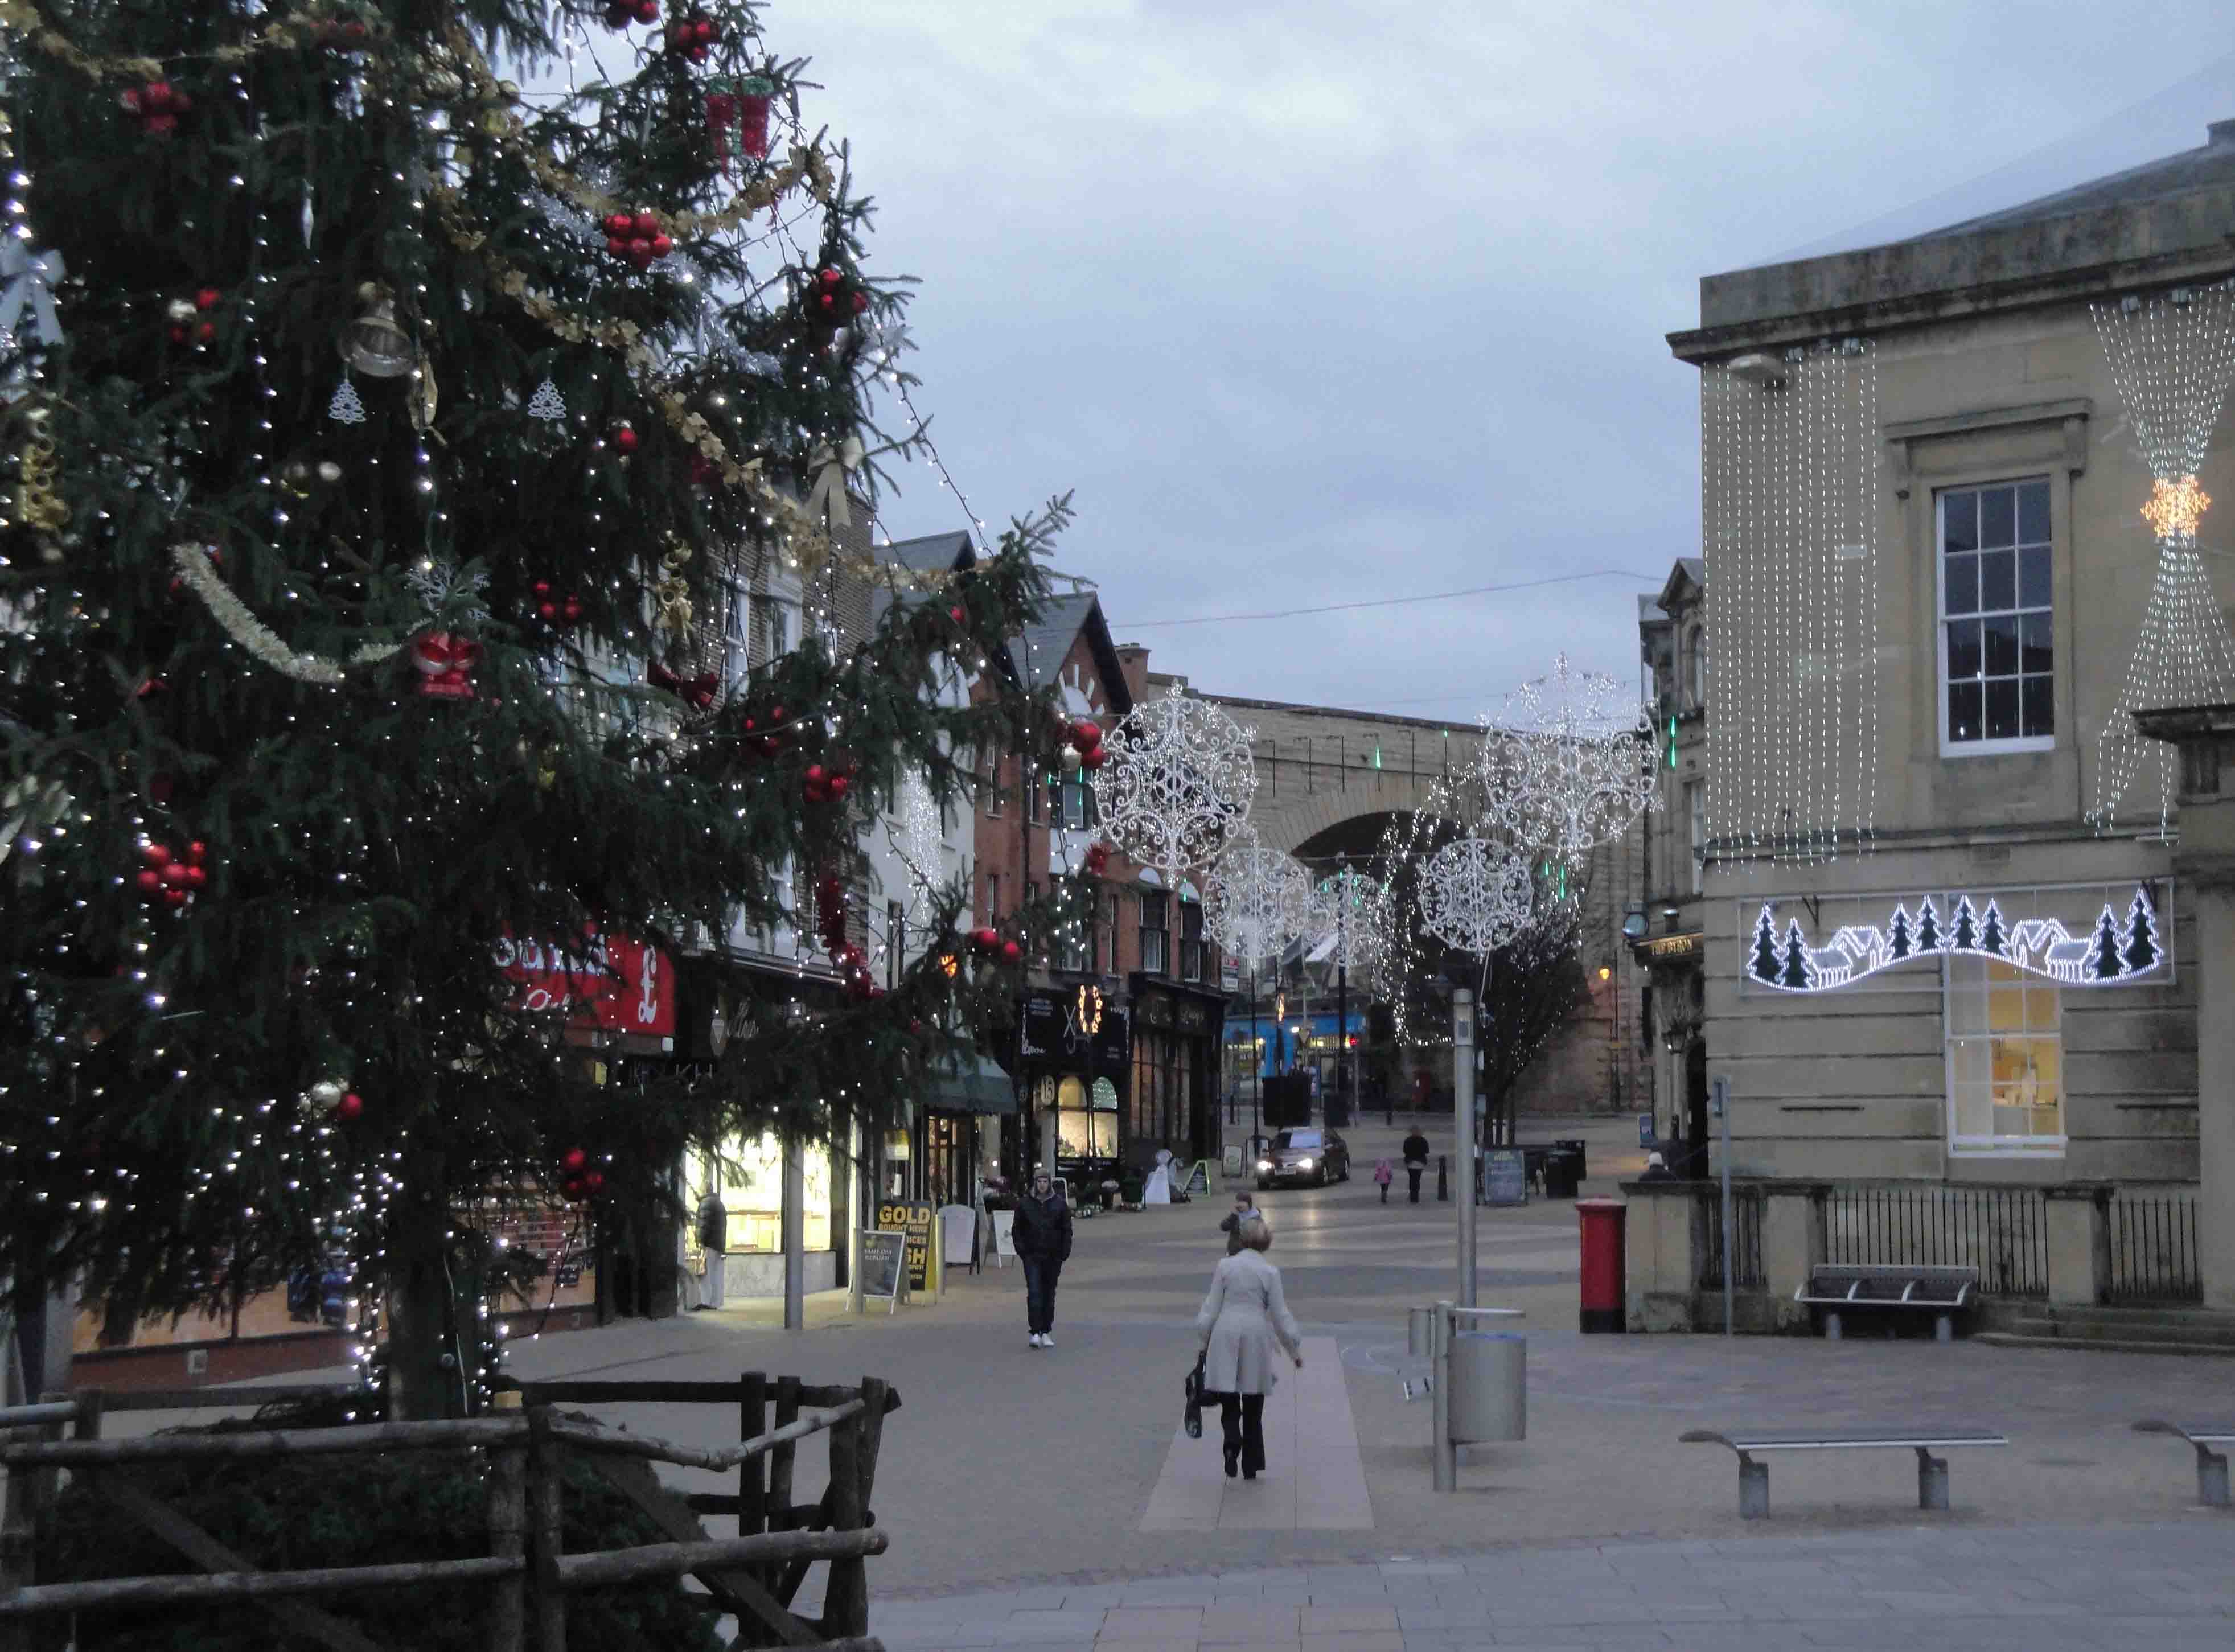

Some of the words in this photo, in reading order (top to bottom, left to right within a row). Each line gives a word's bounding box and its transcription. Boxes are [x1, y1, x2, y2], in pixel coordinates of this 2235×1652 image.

[1651, 942, 1666, 955] THE
[1667, 938, 1692, 954] BYRON
[879, 1205, 931, 1224] GOLD
[909, 1225, 929, 1234] HERE
